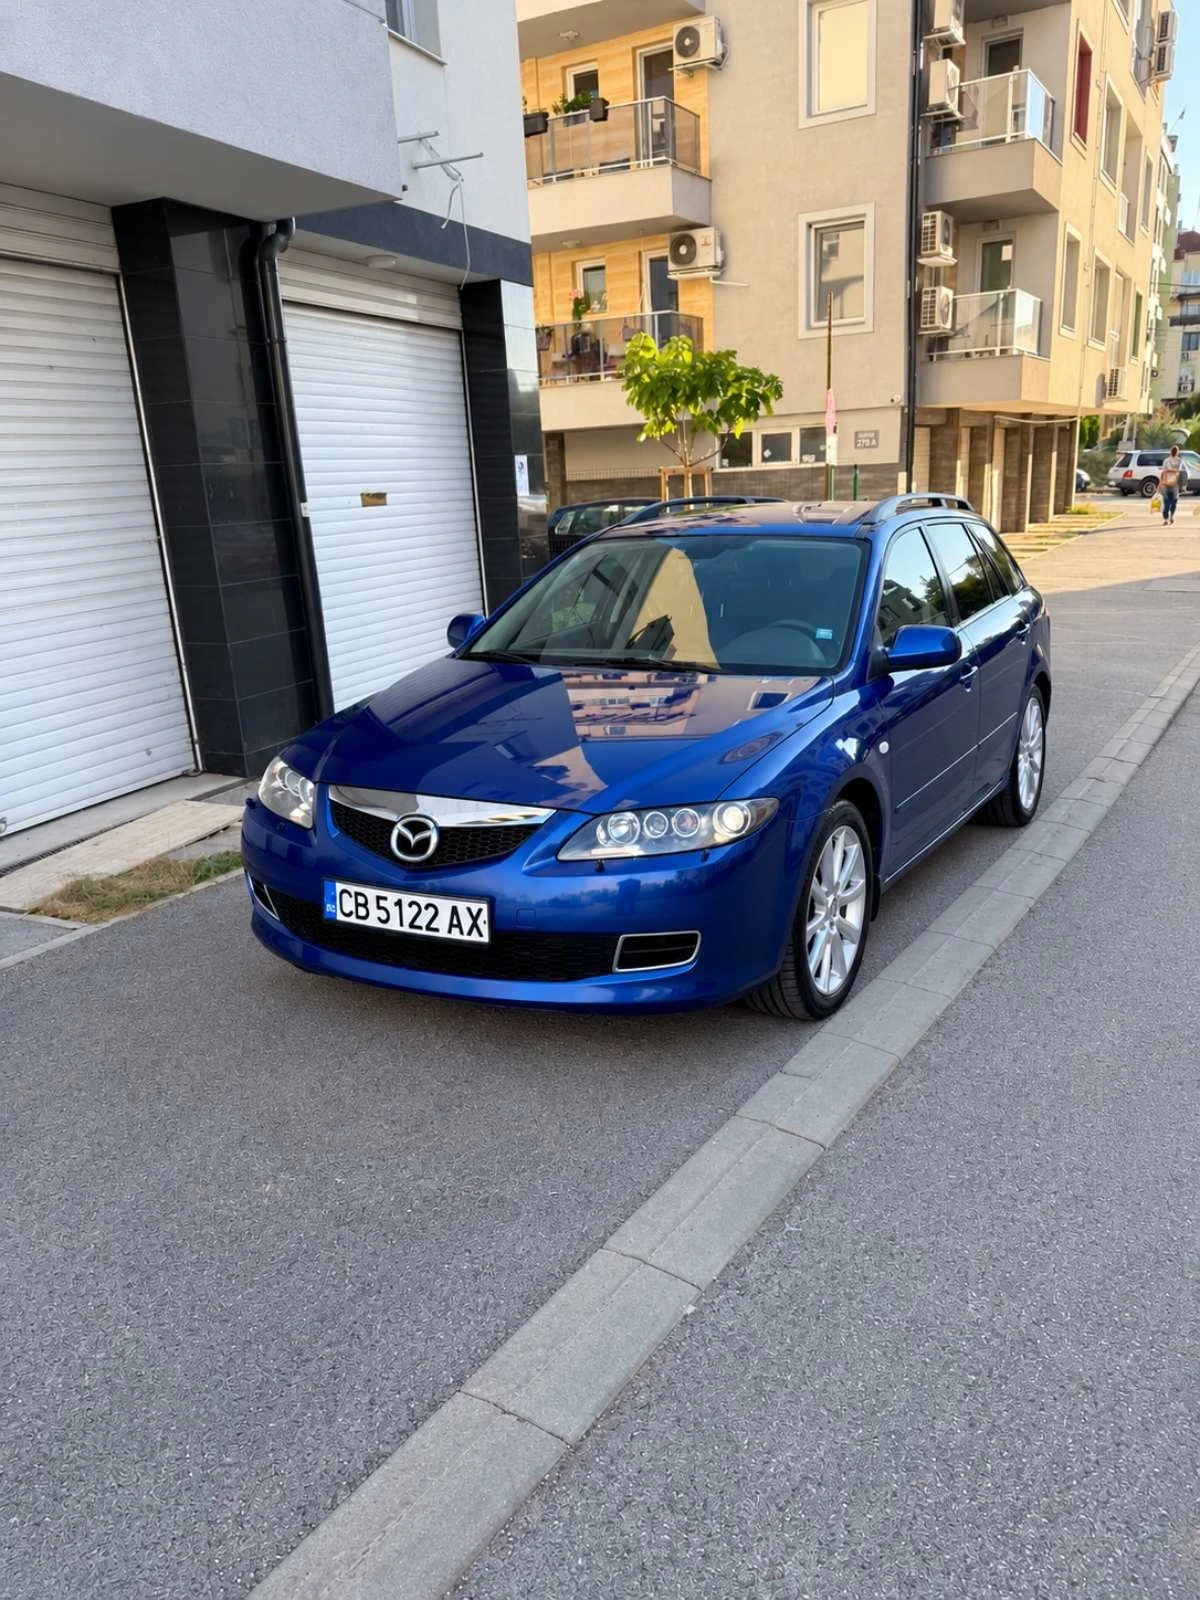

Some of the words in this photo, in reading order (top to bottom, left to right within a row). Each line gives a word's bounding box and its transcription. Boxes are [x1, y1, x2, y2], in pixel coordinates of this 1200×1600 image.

[339, 889, 370, 920] CB
[376, 895, 440, 932] 5122
[447, 905, 484, 937] AX
